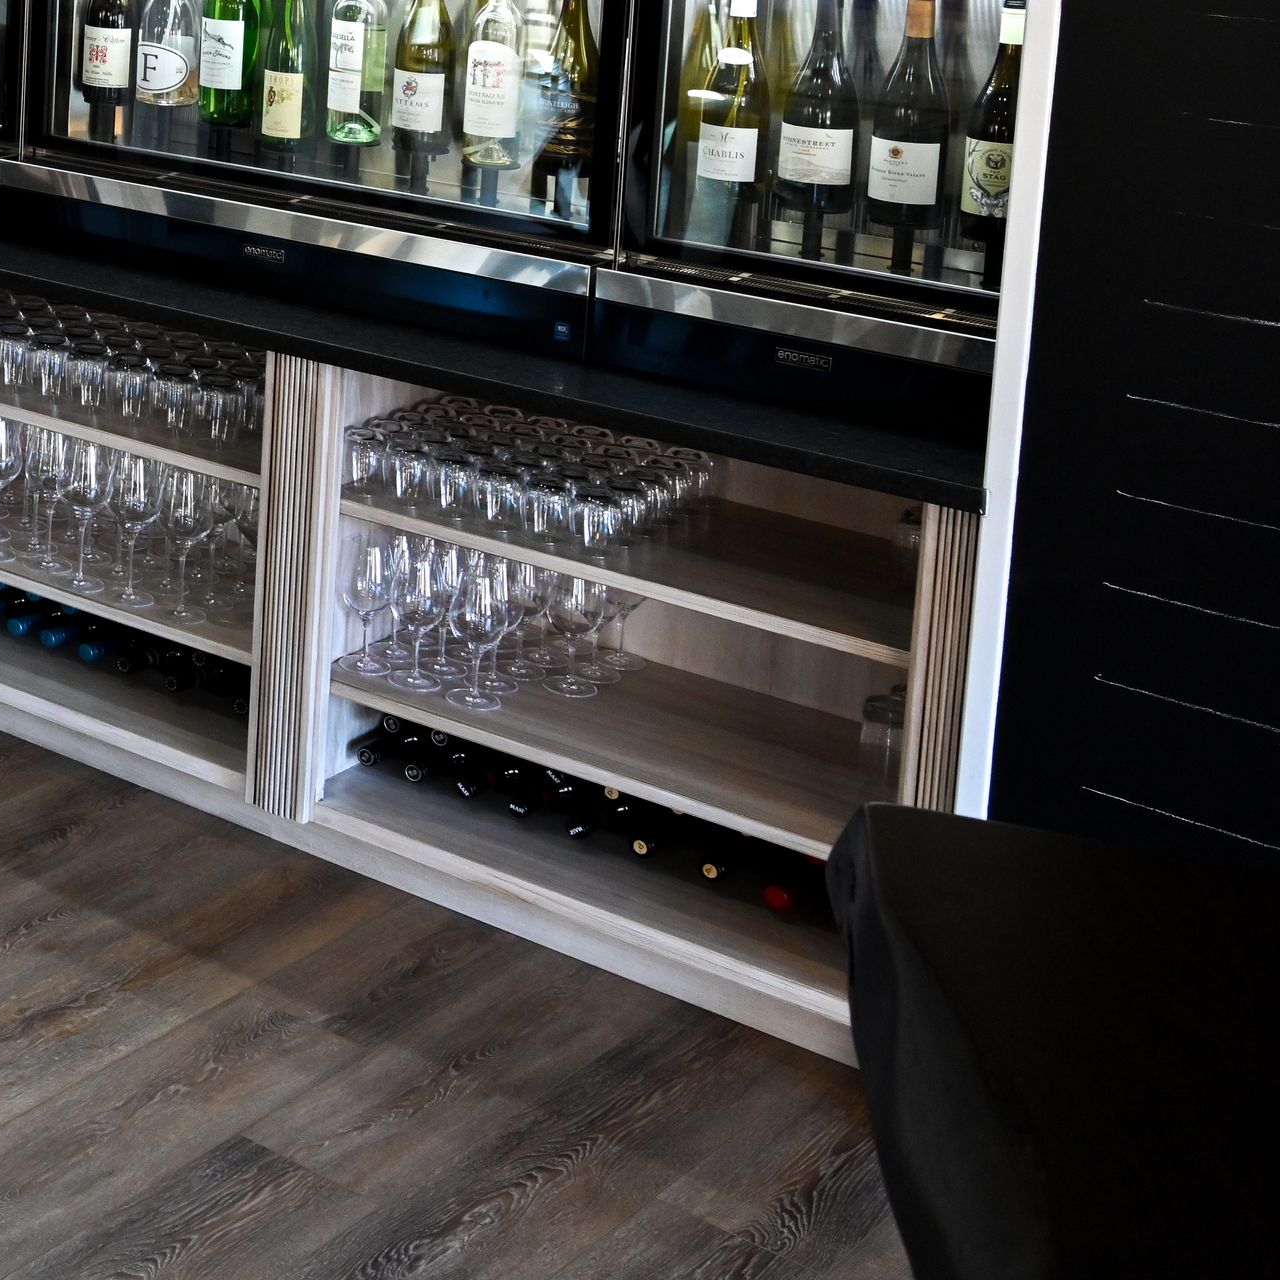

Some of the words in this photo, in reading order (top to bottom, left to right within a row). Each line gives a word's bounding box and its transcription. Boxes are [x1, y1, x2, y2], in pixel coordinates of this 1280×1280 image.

[141, 52, 159, 83] F
[702, 145, 745, 160] CHABLIS
[981, 172, 1008, 182] STAG
[777, 349, 830, 368] enomatic
